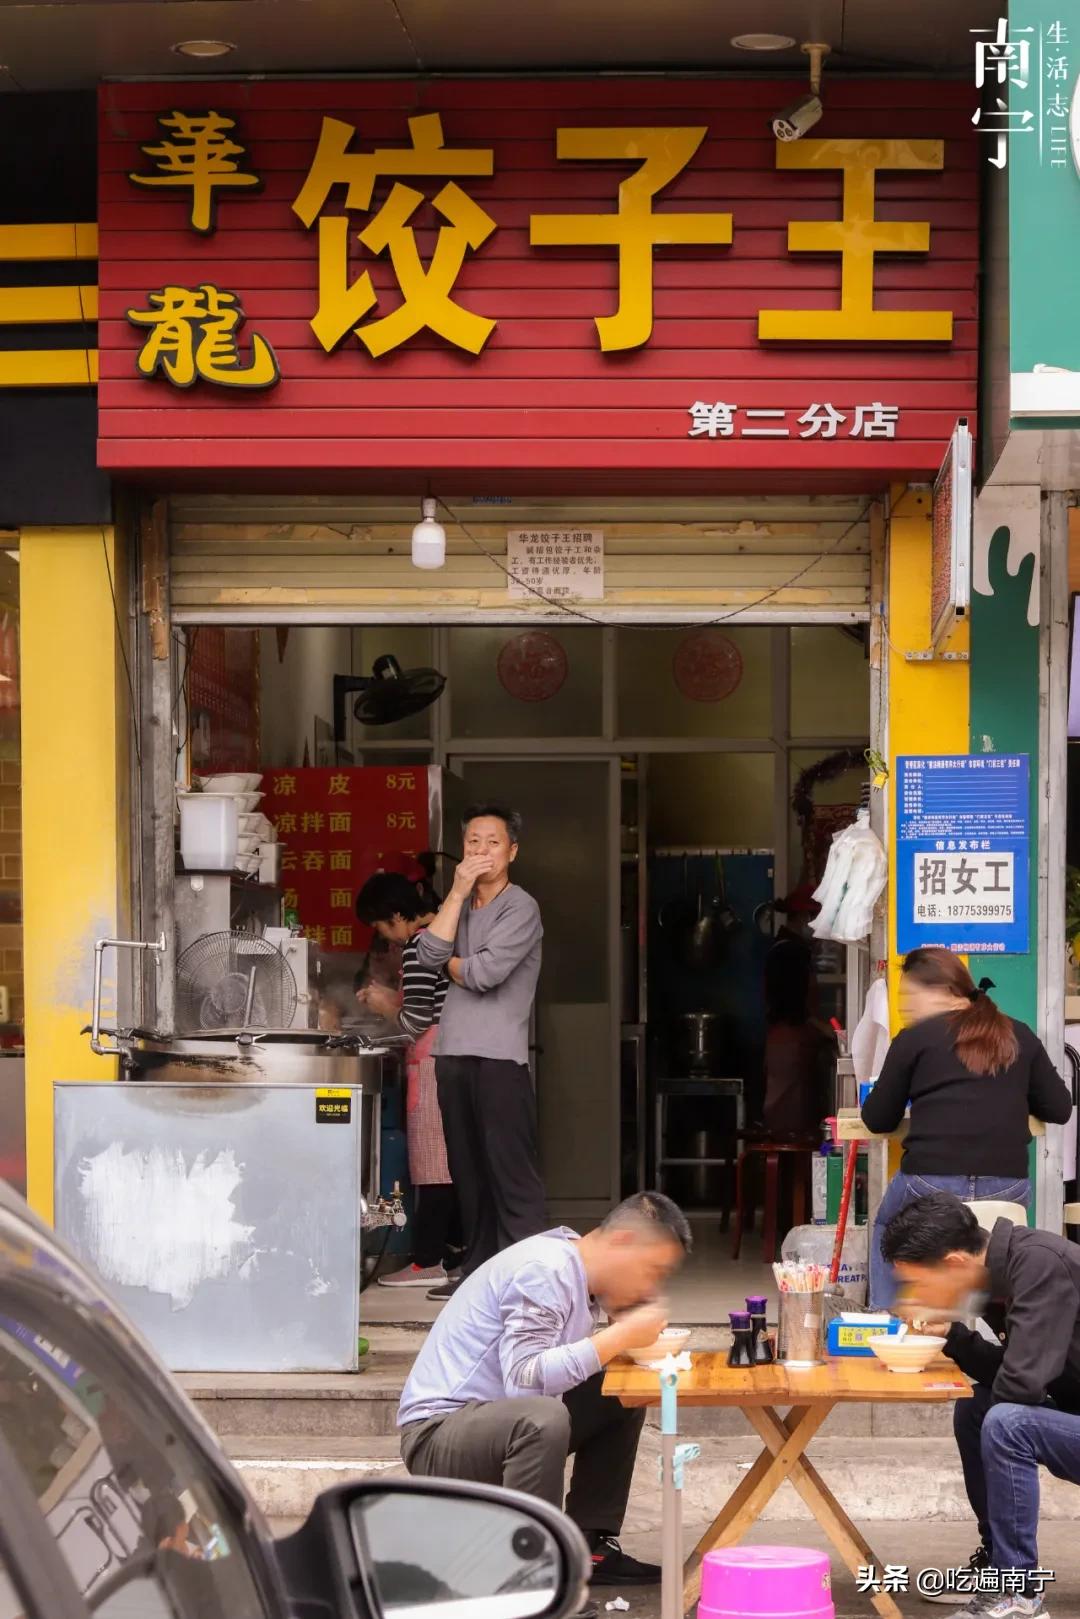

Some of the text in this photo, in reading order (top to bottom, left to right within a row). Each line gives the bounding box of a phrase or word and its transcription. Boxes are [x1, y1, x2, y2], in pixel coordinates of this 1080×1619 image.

[292, 112, 953, 358] 饺子王
[127, 108, 280, 389] 華龍
[688, 401, 899, 439] 第二分店
[518, 533, 593, 544] 华龙饺子王招聘
[386, 773, 416, 790] 8元
[275, 812, 416, 833] 凉拌面 8元
[935, 841, 991, 850] 信息发布栏
[281, 850, 351, 872] 云吞面
[919, 858, 1010, 895] 招女工
